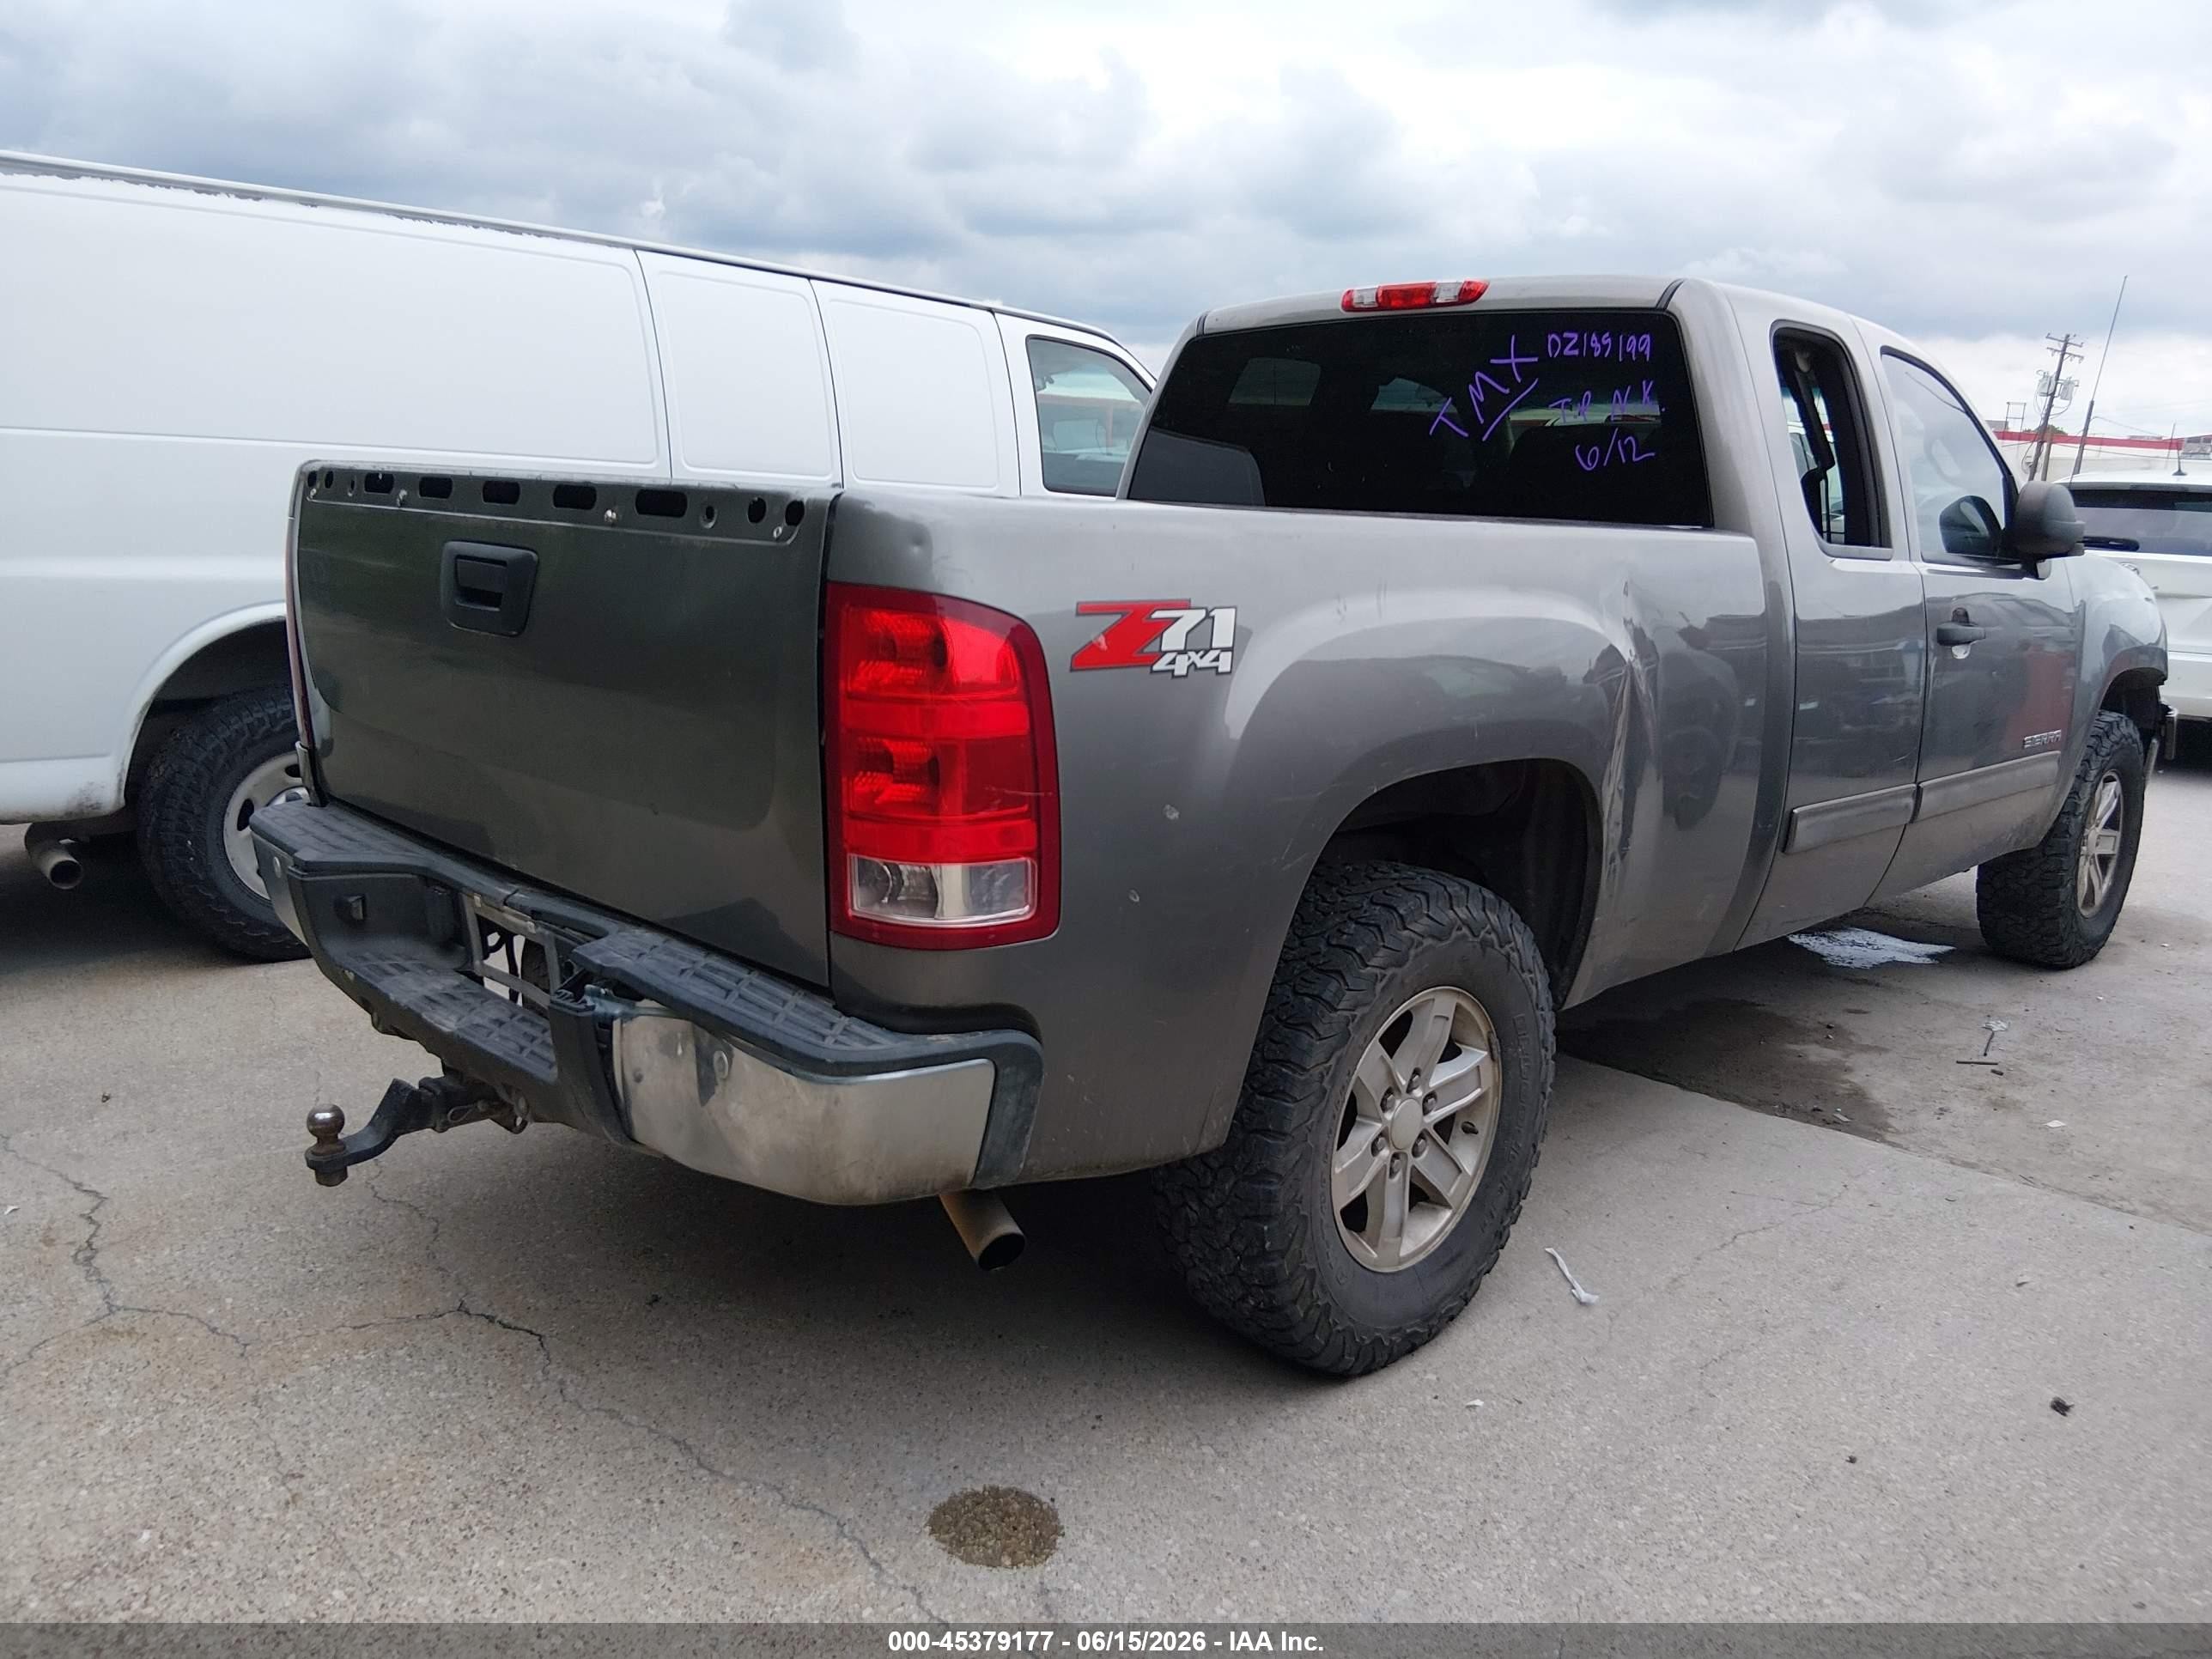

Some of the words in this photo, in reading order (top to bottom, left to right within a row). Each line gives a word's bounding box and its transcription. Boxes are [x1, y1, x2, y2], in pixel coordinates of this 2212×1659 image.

[1429, 334, 1539, 439] TMX
[1574, 427, 1656, 471] 6/12
[1070, 598, 1237, 672] Z71
[2022, 728, 2062, 750] SIERRA
